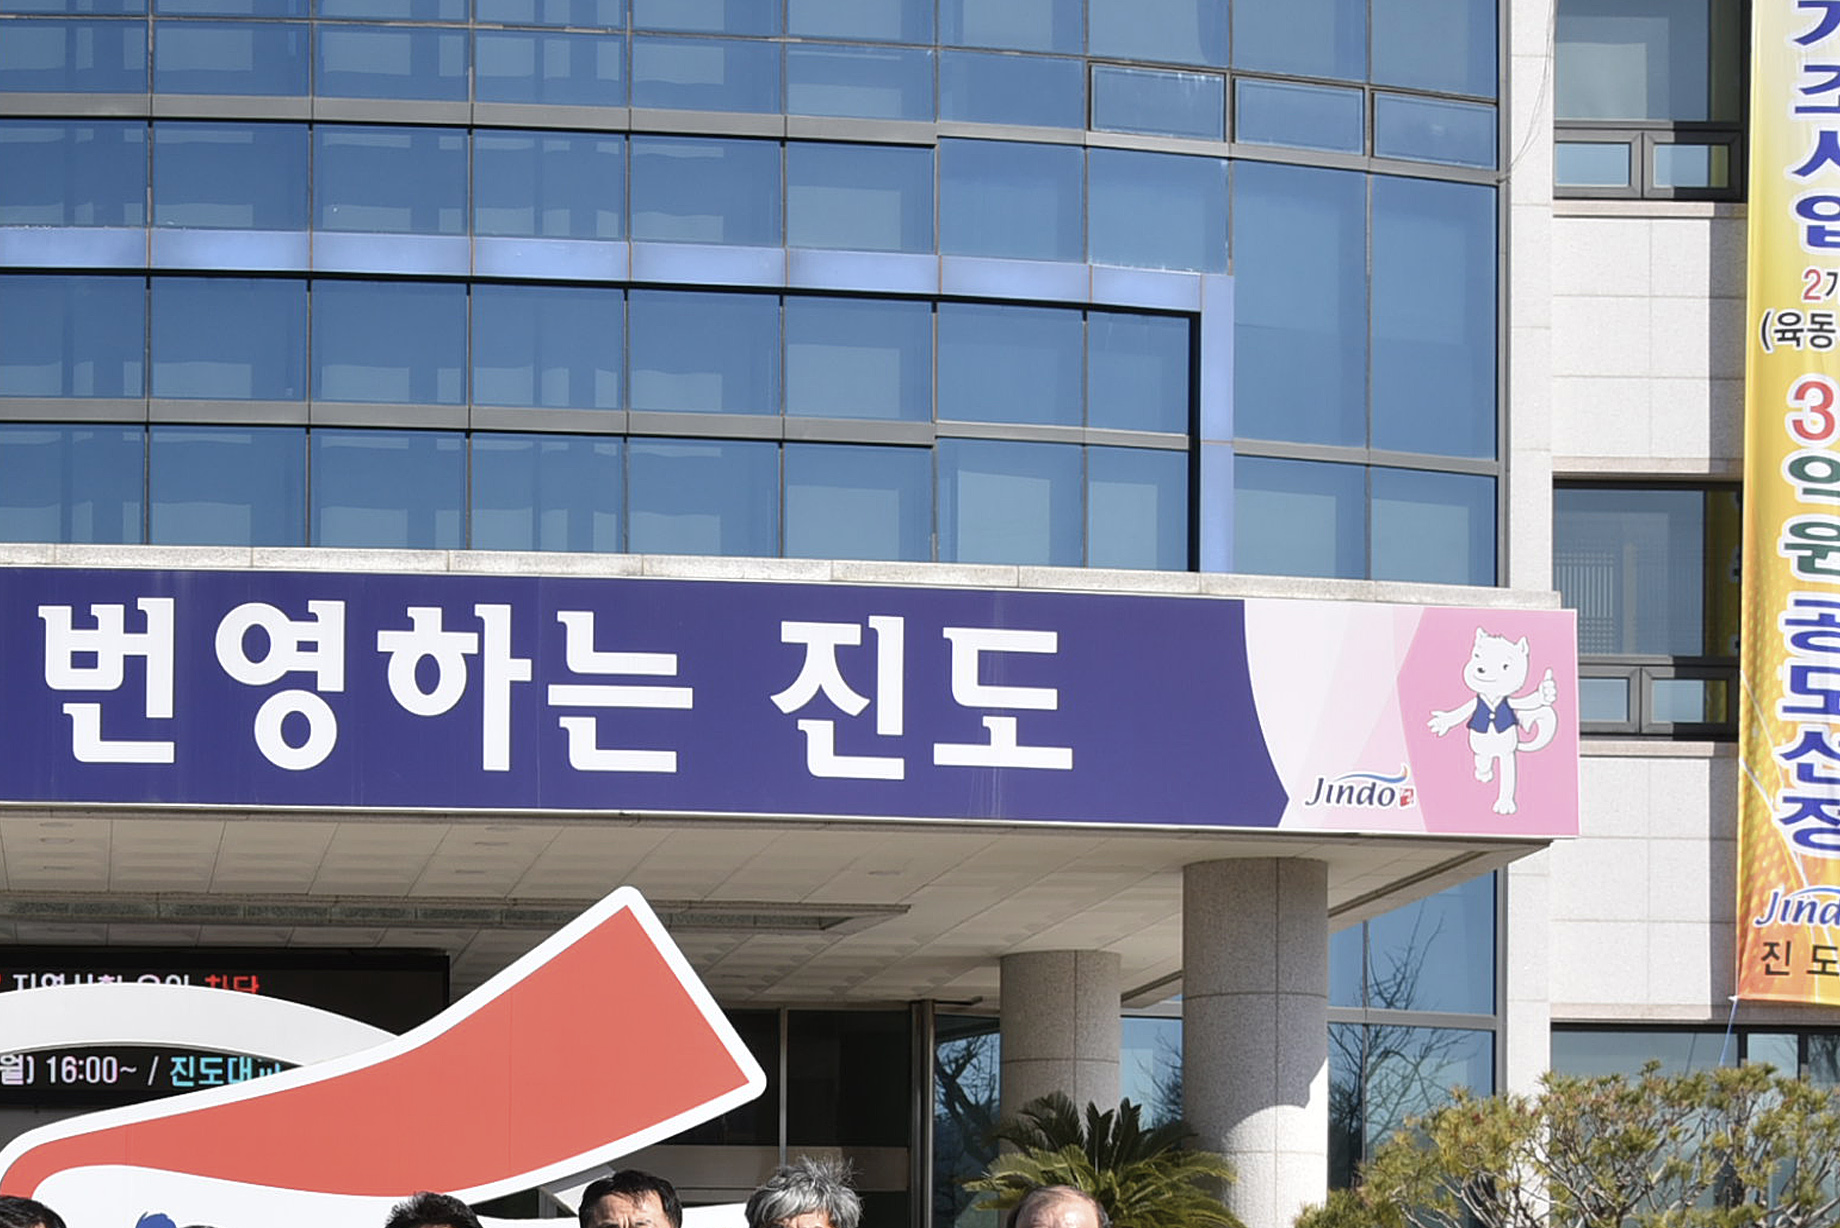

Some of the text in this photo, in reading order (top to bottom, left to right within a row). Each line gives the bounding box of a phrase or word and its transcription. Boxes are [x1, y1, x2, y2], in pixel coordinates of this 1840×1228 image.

[38, 597, 693, 773] 번영하는
[770, 615, 1073, 780] 진도
[1304, 774, 1398, 808] Jindo
